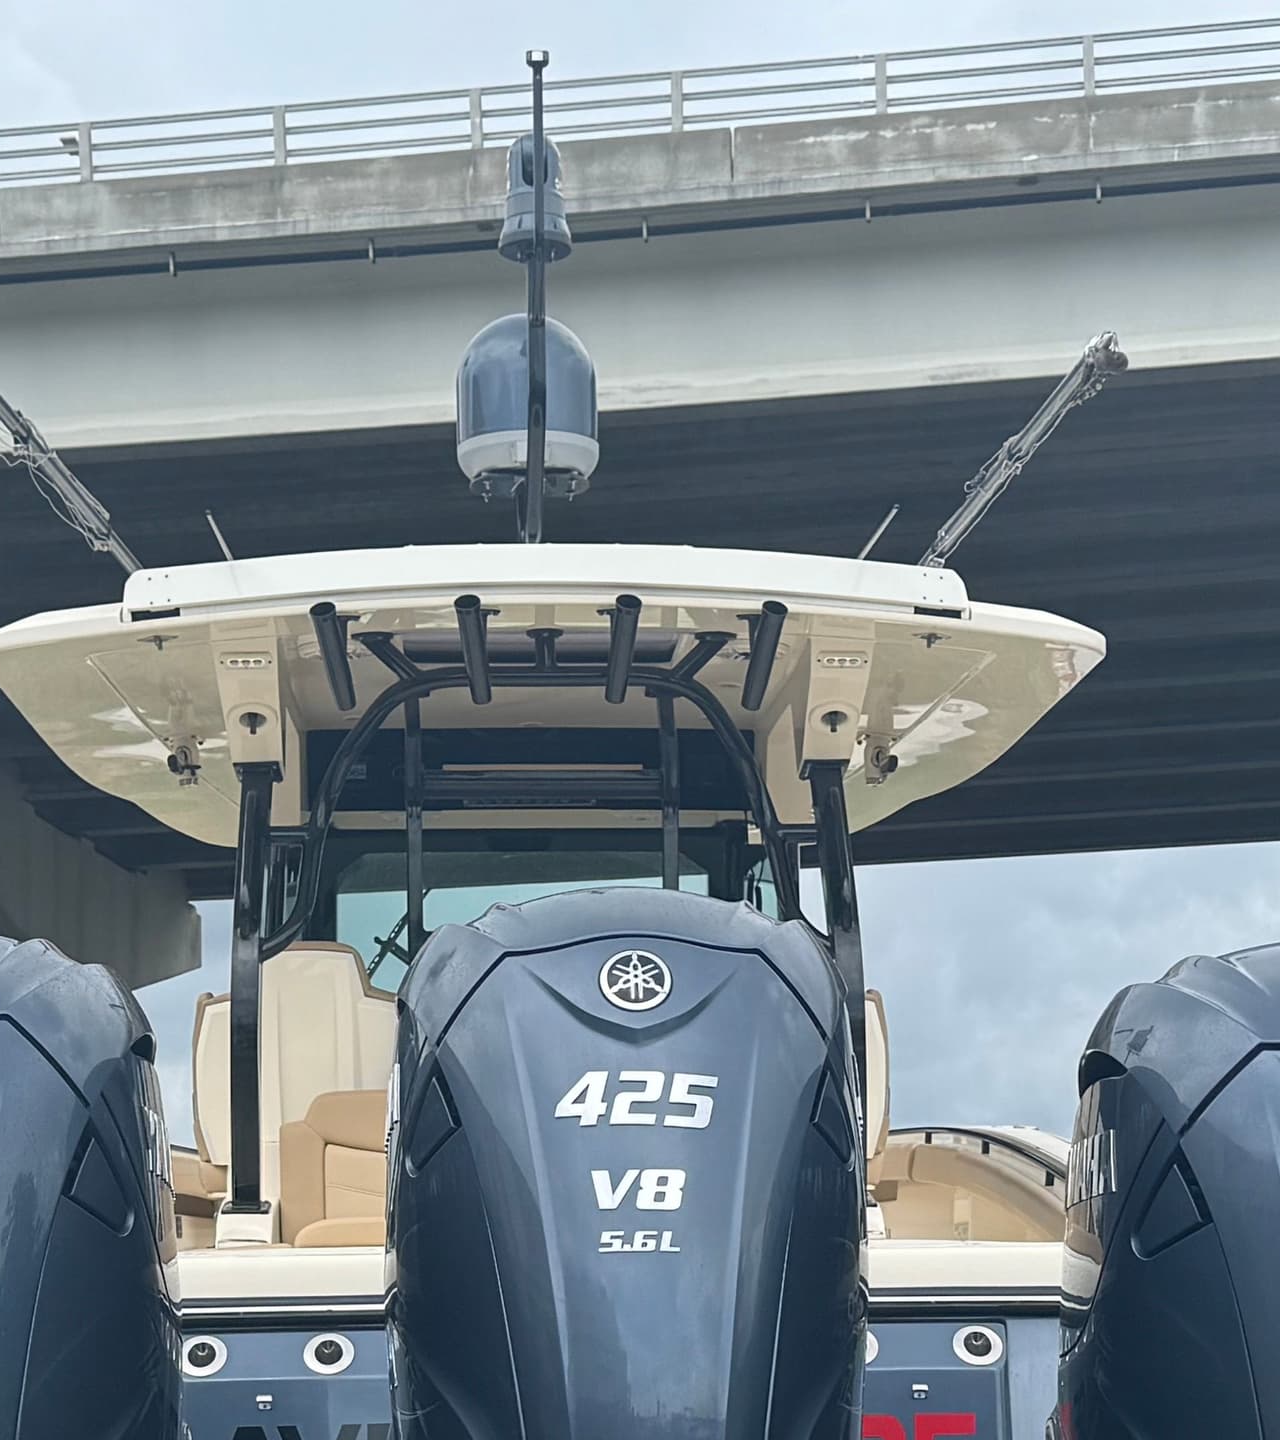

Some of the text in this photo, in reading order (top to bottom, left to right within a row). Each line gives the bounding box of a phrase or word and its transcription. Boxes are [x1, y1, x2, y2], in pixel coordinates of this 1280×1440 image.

[554, 1070, 719, 1129] 425
[590, 1168, 687, 1211] V8
[598, 1230, 681, 1253] 5.6L
